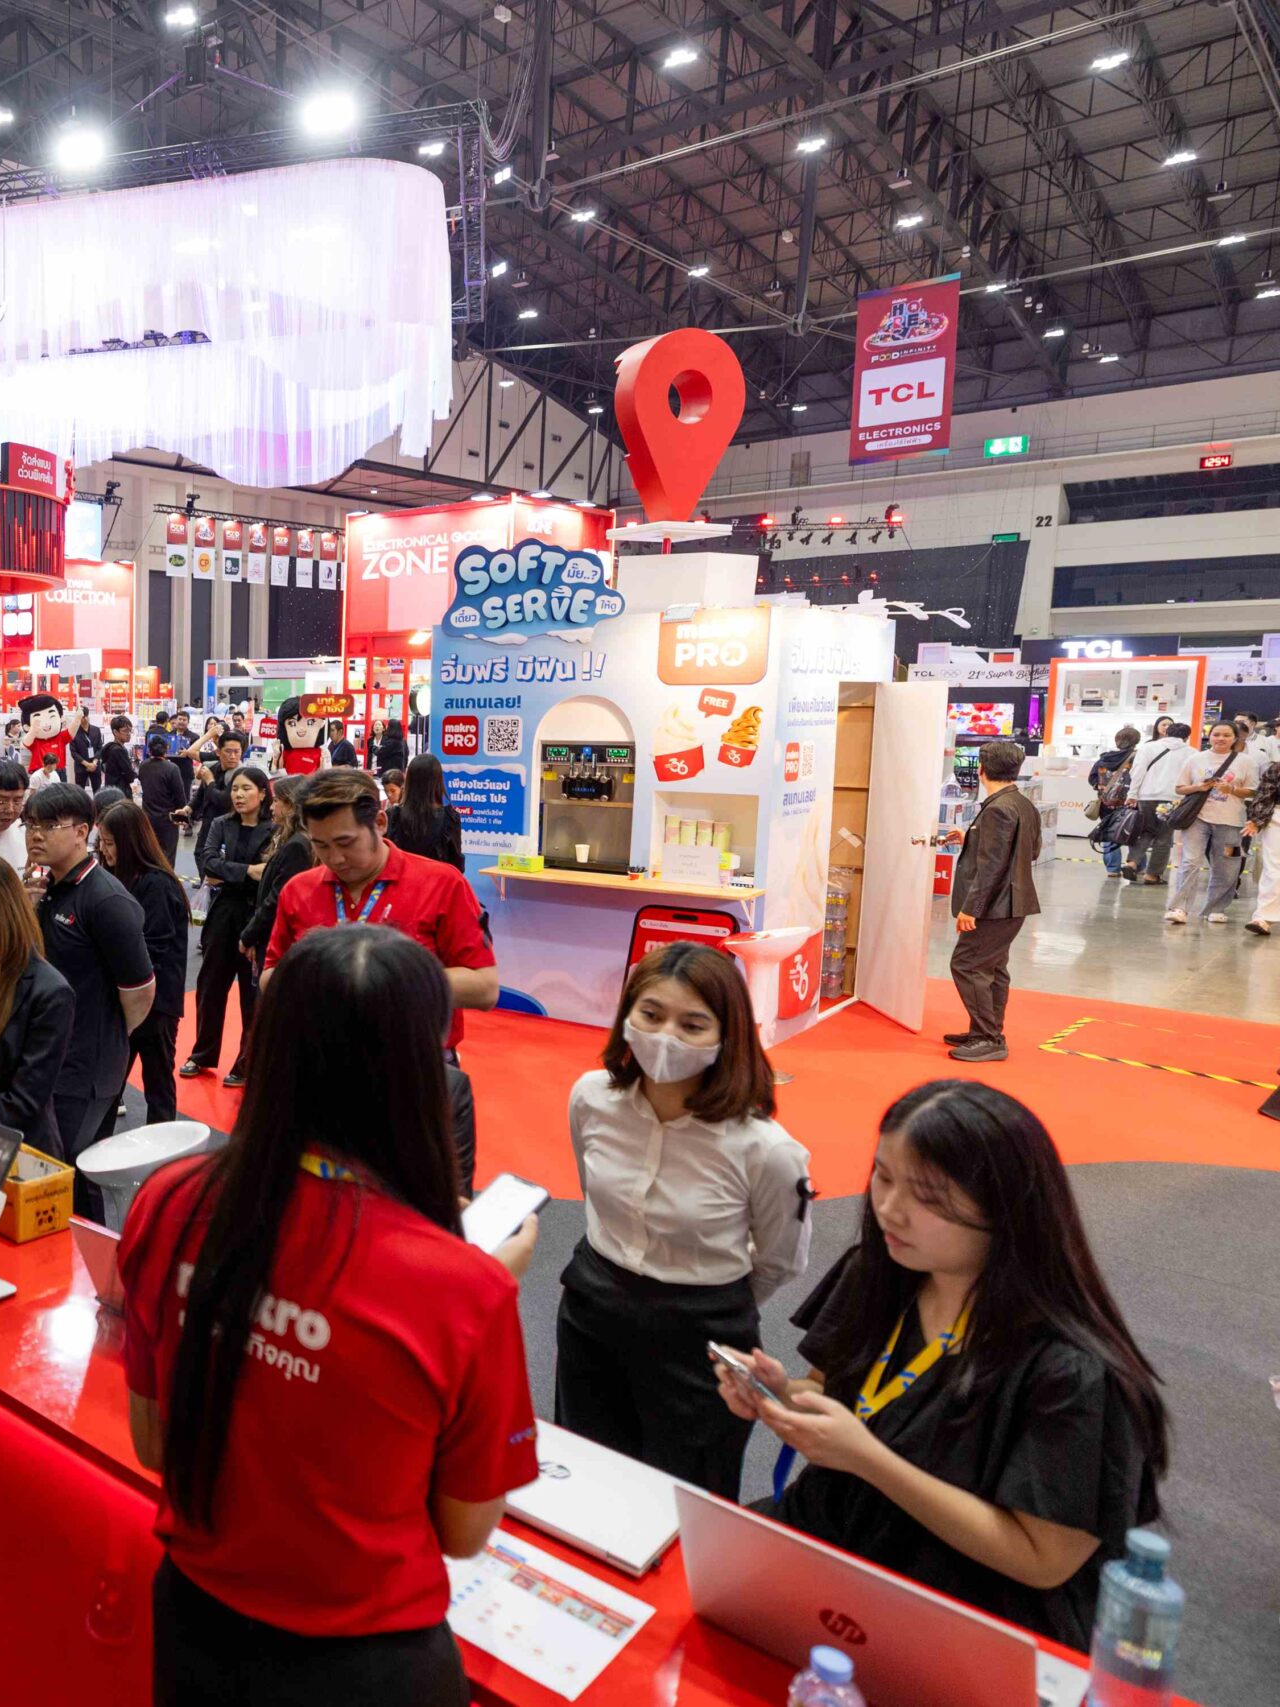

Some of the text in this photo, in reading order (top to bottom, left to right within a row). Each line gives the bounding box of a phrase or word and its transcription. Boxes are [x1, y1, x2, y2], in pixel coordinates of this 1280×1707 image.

[871, 351, 900, 363] FOOD
[868, 381, 935, 406] TCL
[859, 422, 942, 441] ELECTRONICS
[1035, 515, 1052, 528] 22
[363, 532, 448, 551] ELECTRONICAL
[362, 546, 448, 581] ZONE
[459, 545, 566, 596] SOFT
[45, 590, 116, 606] COLLECTION
[482, 586, 596, 629] SERVE
[675, 641, 748, 667] PRO
[1061, 640, 1133, 659] TCL
[440, 653, 508, 684] อิ่มฟรี
[516, 654, 576, 683] มีฟิน
[986, 669, 1014, 680] Super
[444, 695, 522, 710] สแกนเลย!
[703, 695, 729, 709] FREE
[445, 722, 477, 733] makro
[444, 733, 477, 748] PRO
[785, 760, 799, 774] PRO
[490, 793, 507, 803] โปร
